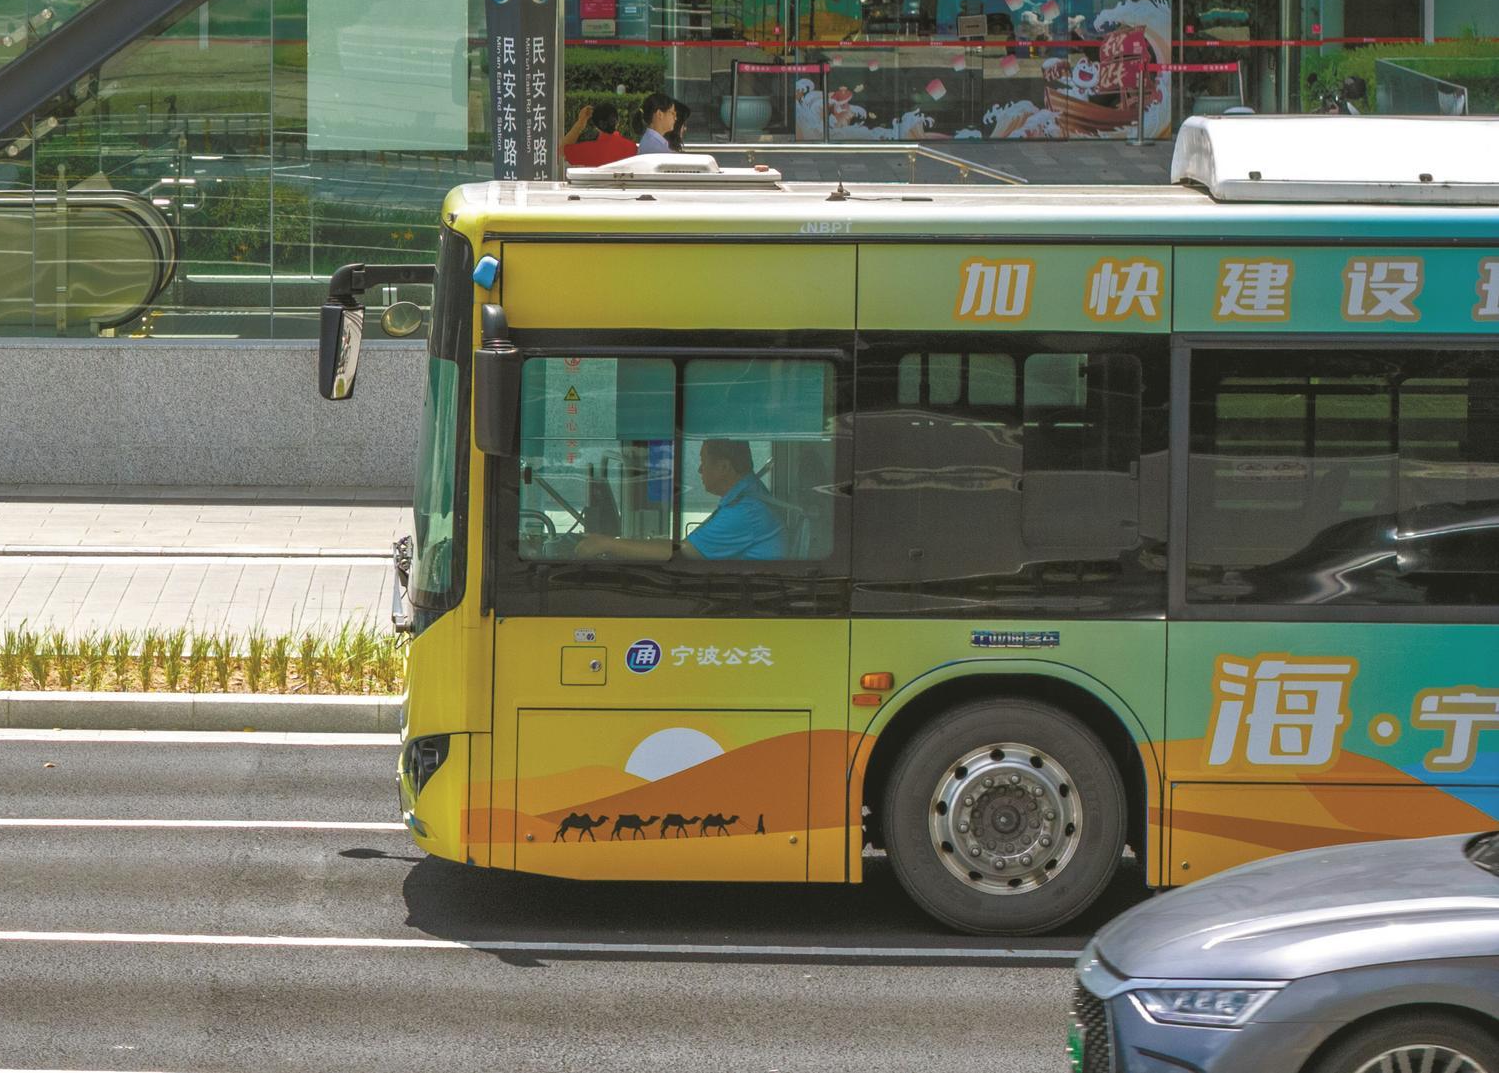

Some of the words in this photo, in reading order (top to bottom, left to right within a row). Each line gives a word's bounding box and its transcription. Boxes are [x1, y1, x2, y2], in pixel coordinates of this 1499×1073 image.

[496, 96, 503, 112] Rd
[525, 98, 532, 113] Rd
[671, 645, 774, 666] 宁波公交
